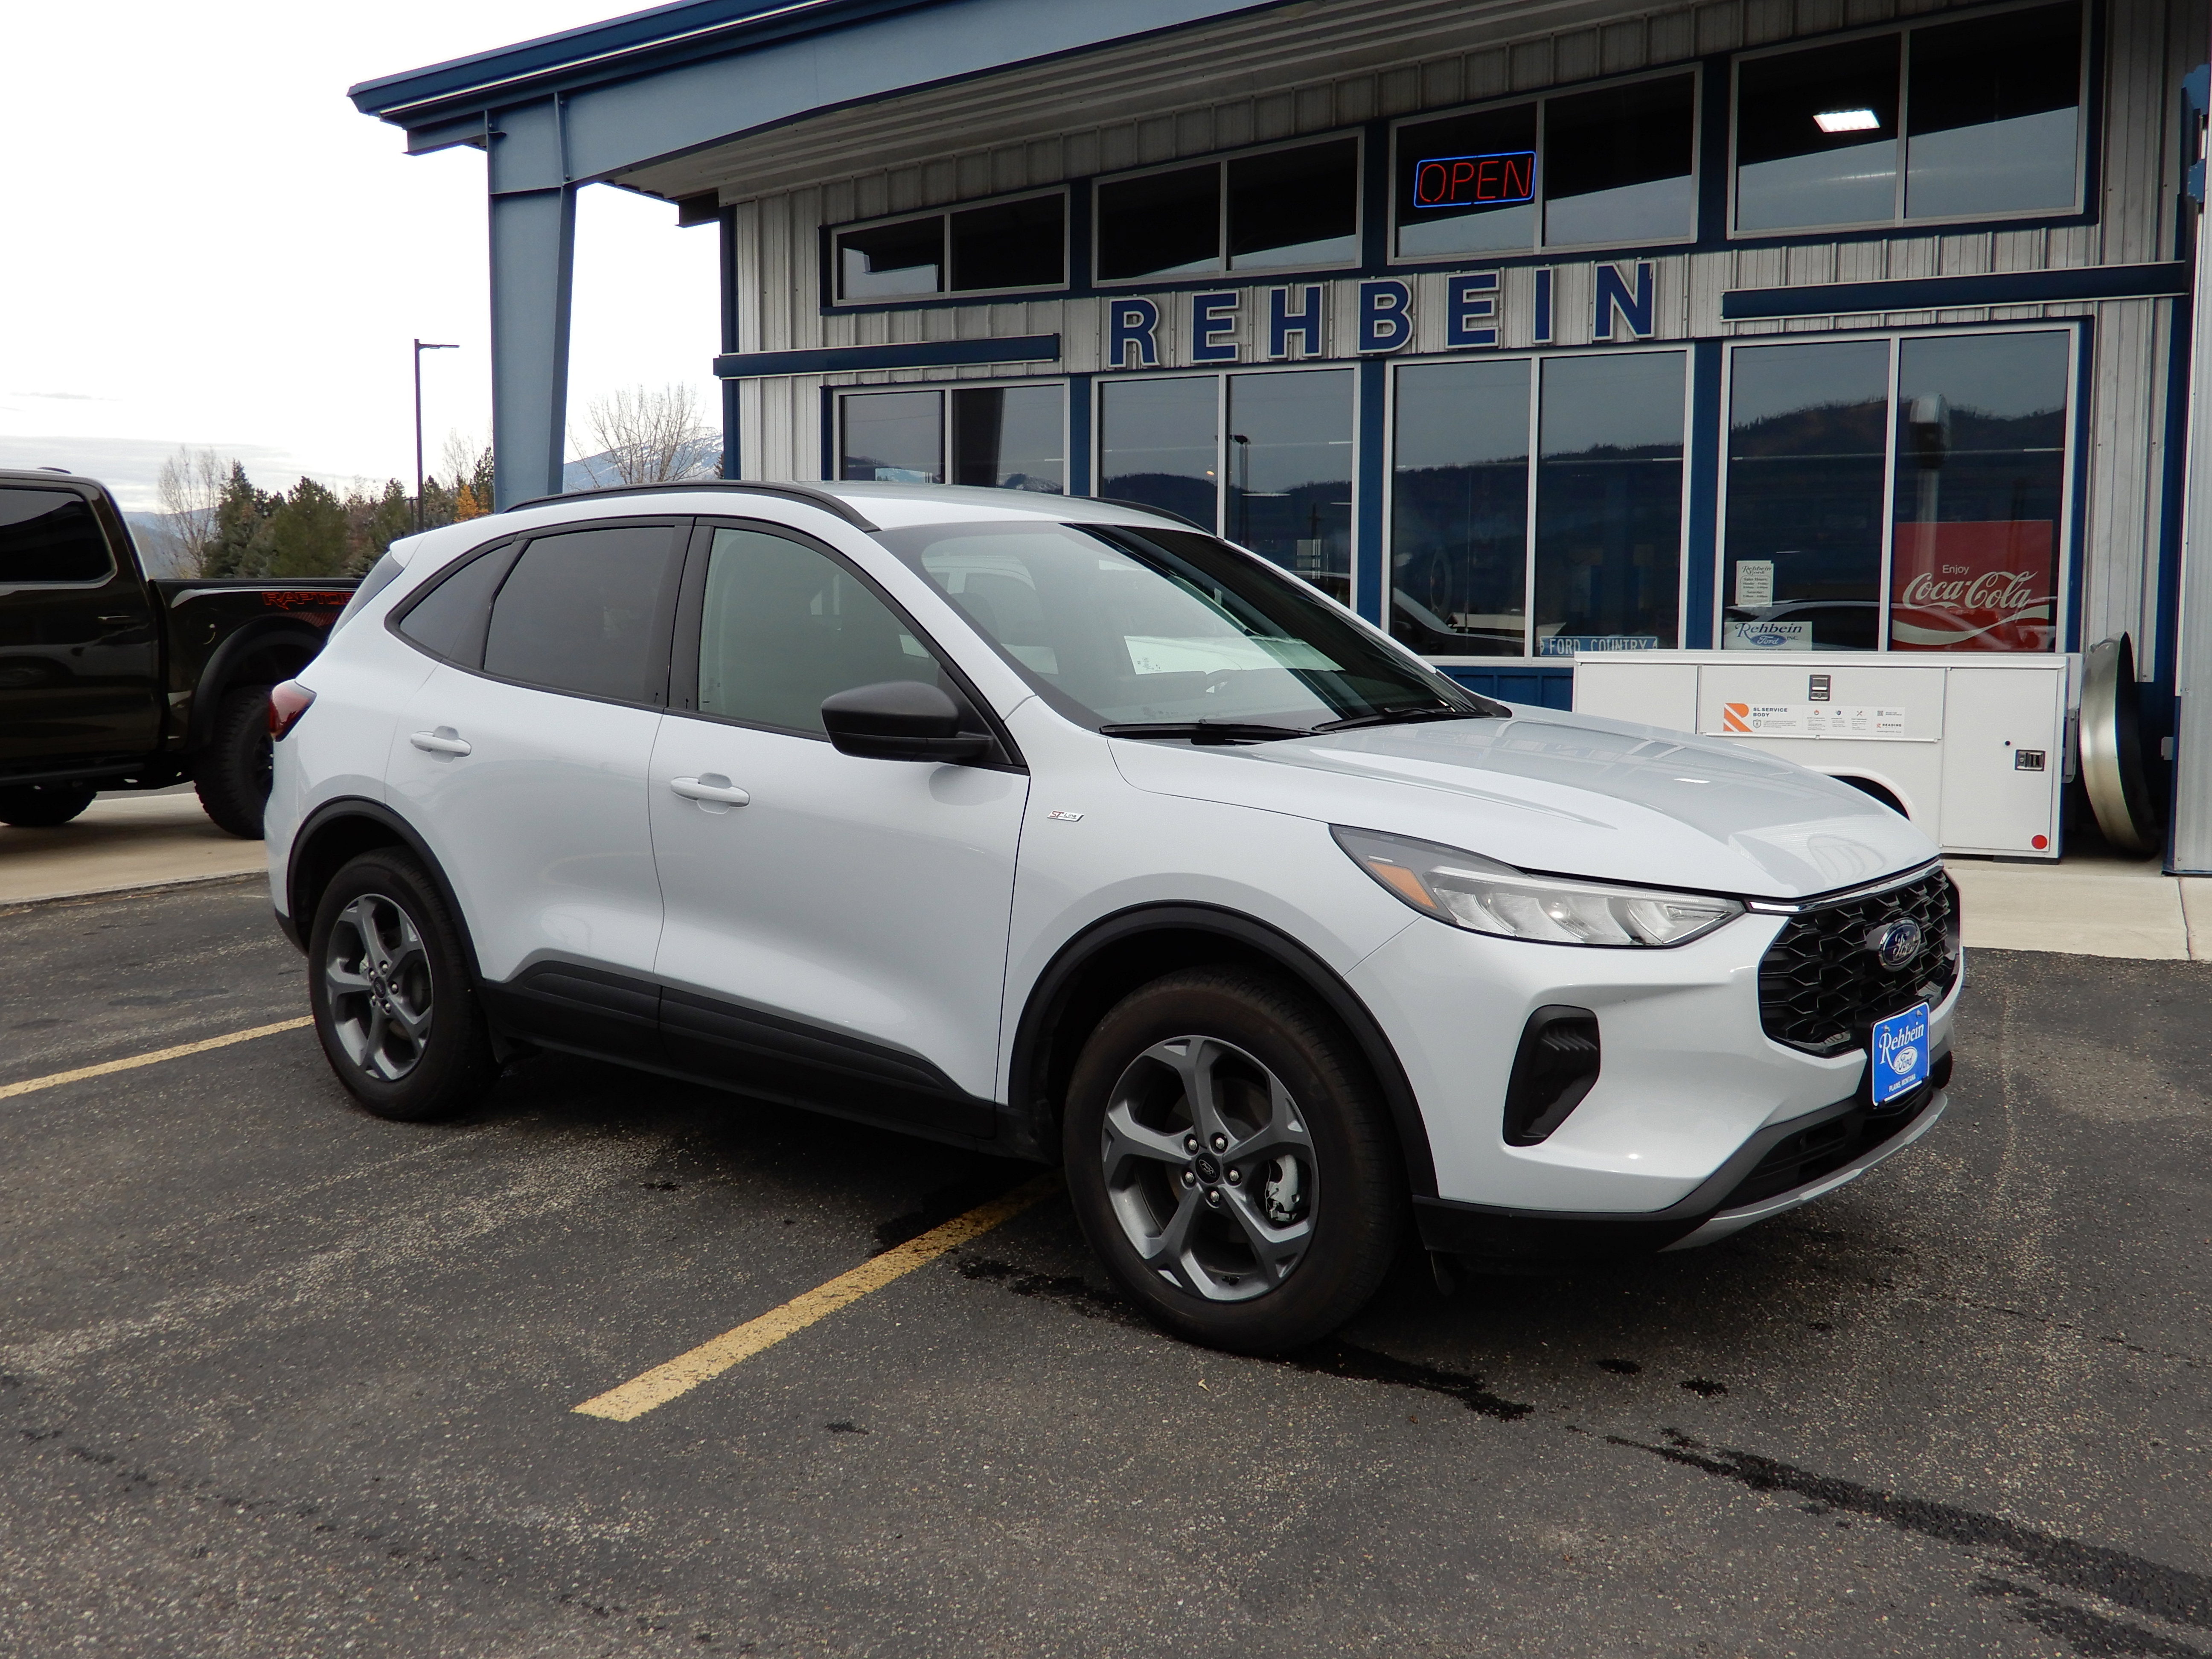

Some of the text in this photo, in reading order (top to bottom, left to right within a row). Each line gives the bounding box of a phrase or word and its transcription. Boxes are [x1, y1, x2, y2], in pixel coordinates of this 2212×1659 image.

[1419, 157, 1532, 203] OPEN
[1108, 259, 1657, 368] REHBEIN
[1942, 565, 1970, 574] Enjoy
[1902, 570, 2038, 609] Coca-Cola
[1735, 623, 1802, 641] Rehbein
[1757, 635, 1780, 645] Ford
[1549, 639, 1647, 654] FORD COUNTRY
[1890, 931, 1917, 960] Ford
[1879, 1022, 1924, 1070] Rehbein
[1896, 1051, 1913, 1071] Ford
